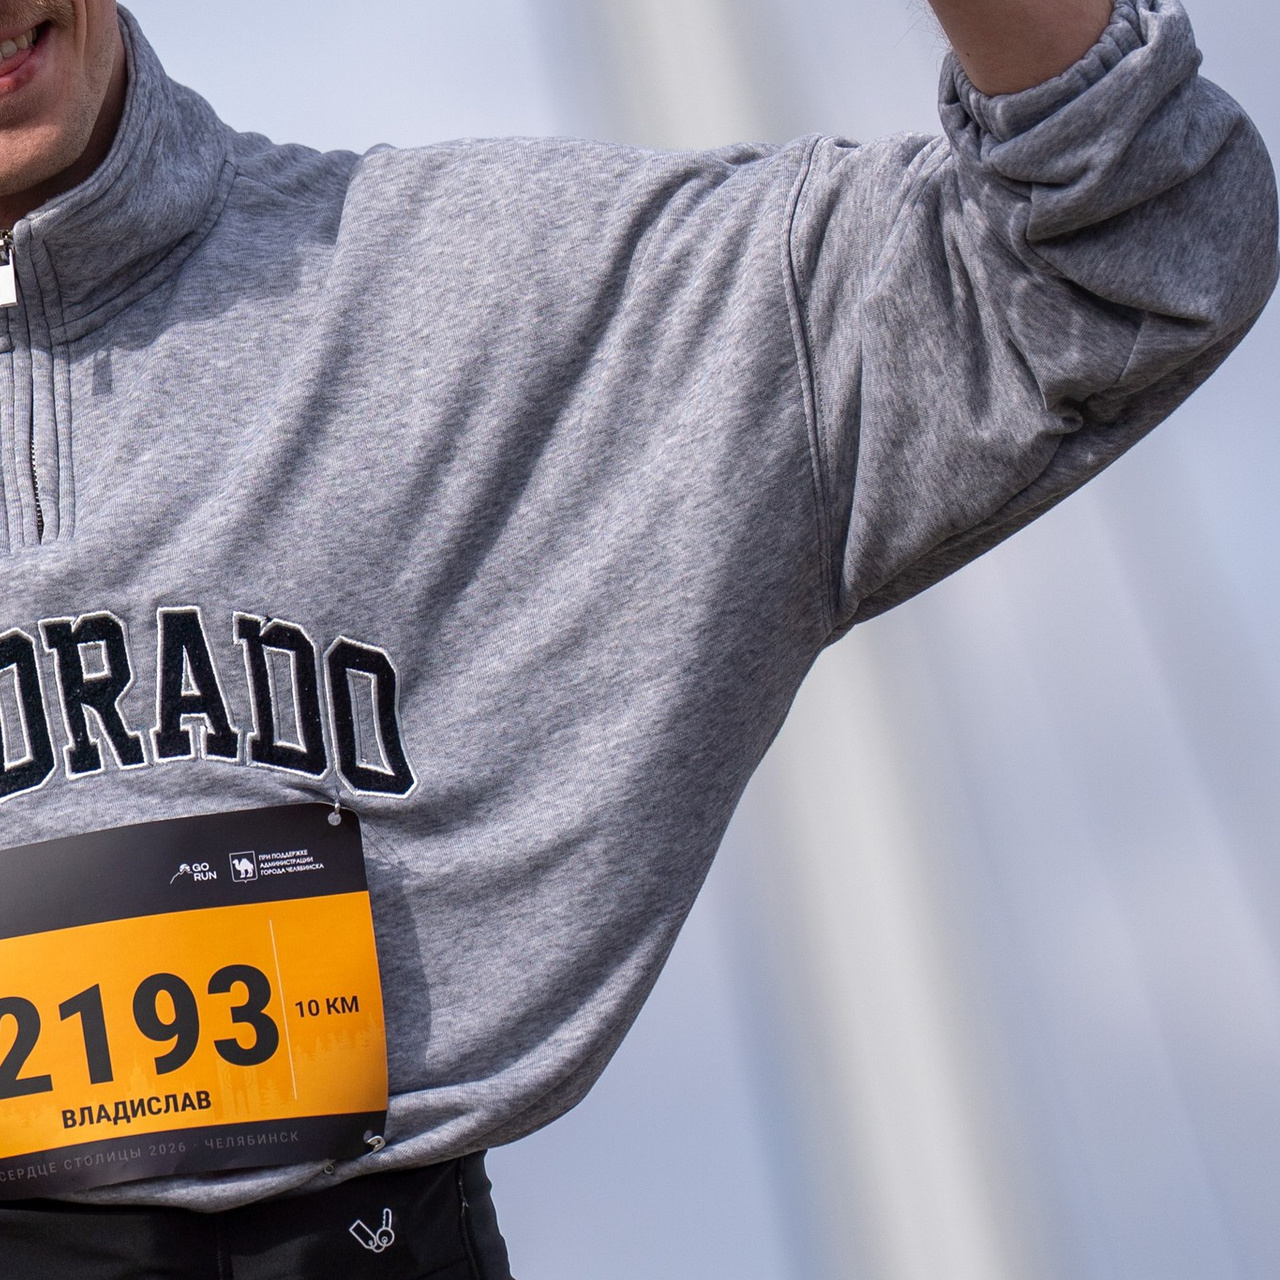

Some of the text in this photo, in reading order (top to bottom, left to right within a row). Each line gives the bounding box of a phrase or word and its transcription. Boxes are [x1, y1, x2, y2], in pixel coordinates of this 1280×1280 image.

[258, 849, 308, 862] ПРИ ПОДДЕРЖКЕ
[192, 862, 210, 872] GO
[260, 856, 314, 869] АДМИНИСТРАЦИИ
[194, 870, 218, 882] RUN
[260, 863, 325, 876] ГОРОДА ЧЕЛЯБИНСКА
[294, 998, 319, 1019] 10
[61, 1090, 212, 1130] ВЛАДИСЛАВ
[63, 1147, 142, 1171] СТОЛИЦЫ
[148, 1142, 187, 1157] 2026
[204, 1131, 299, 1150] ЧЕЛЯБИНСК
